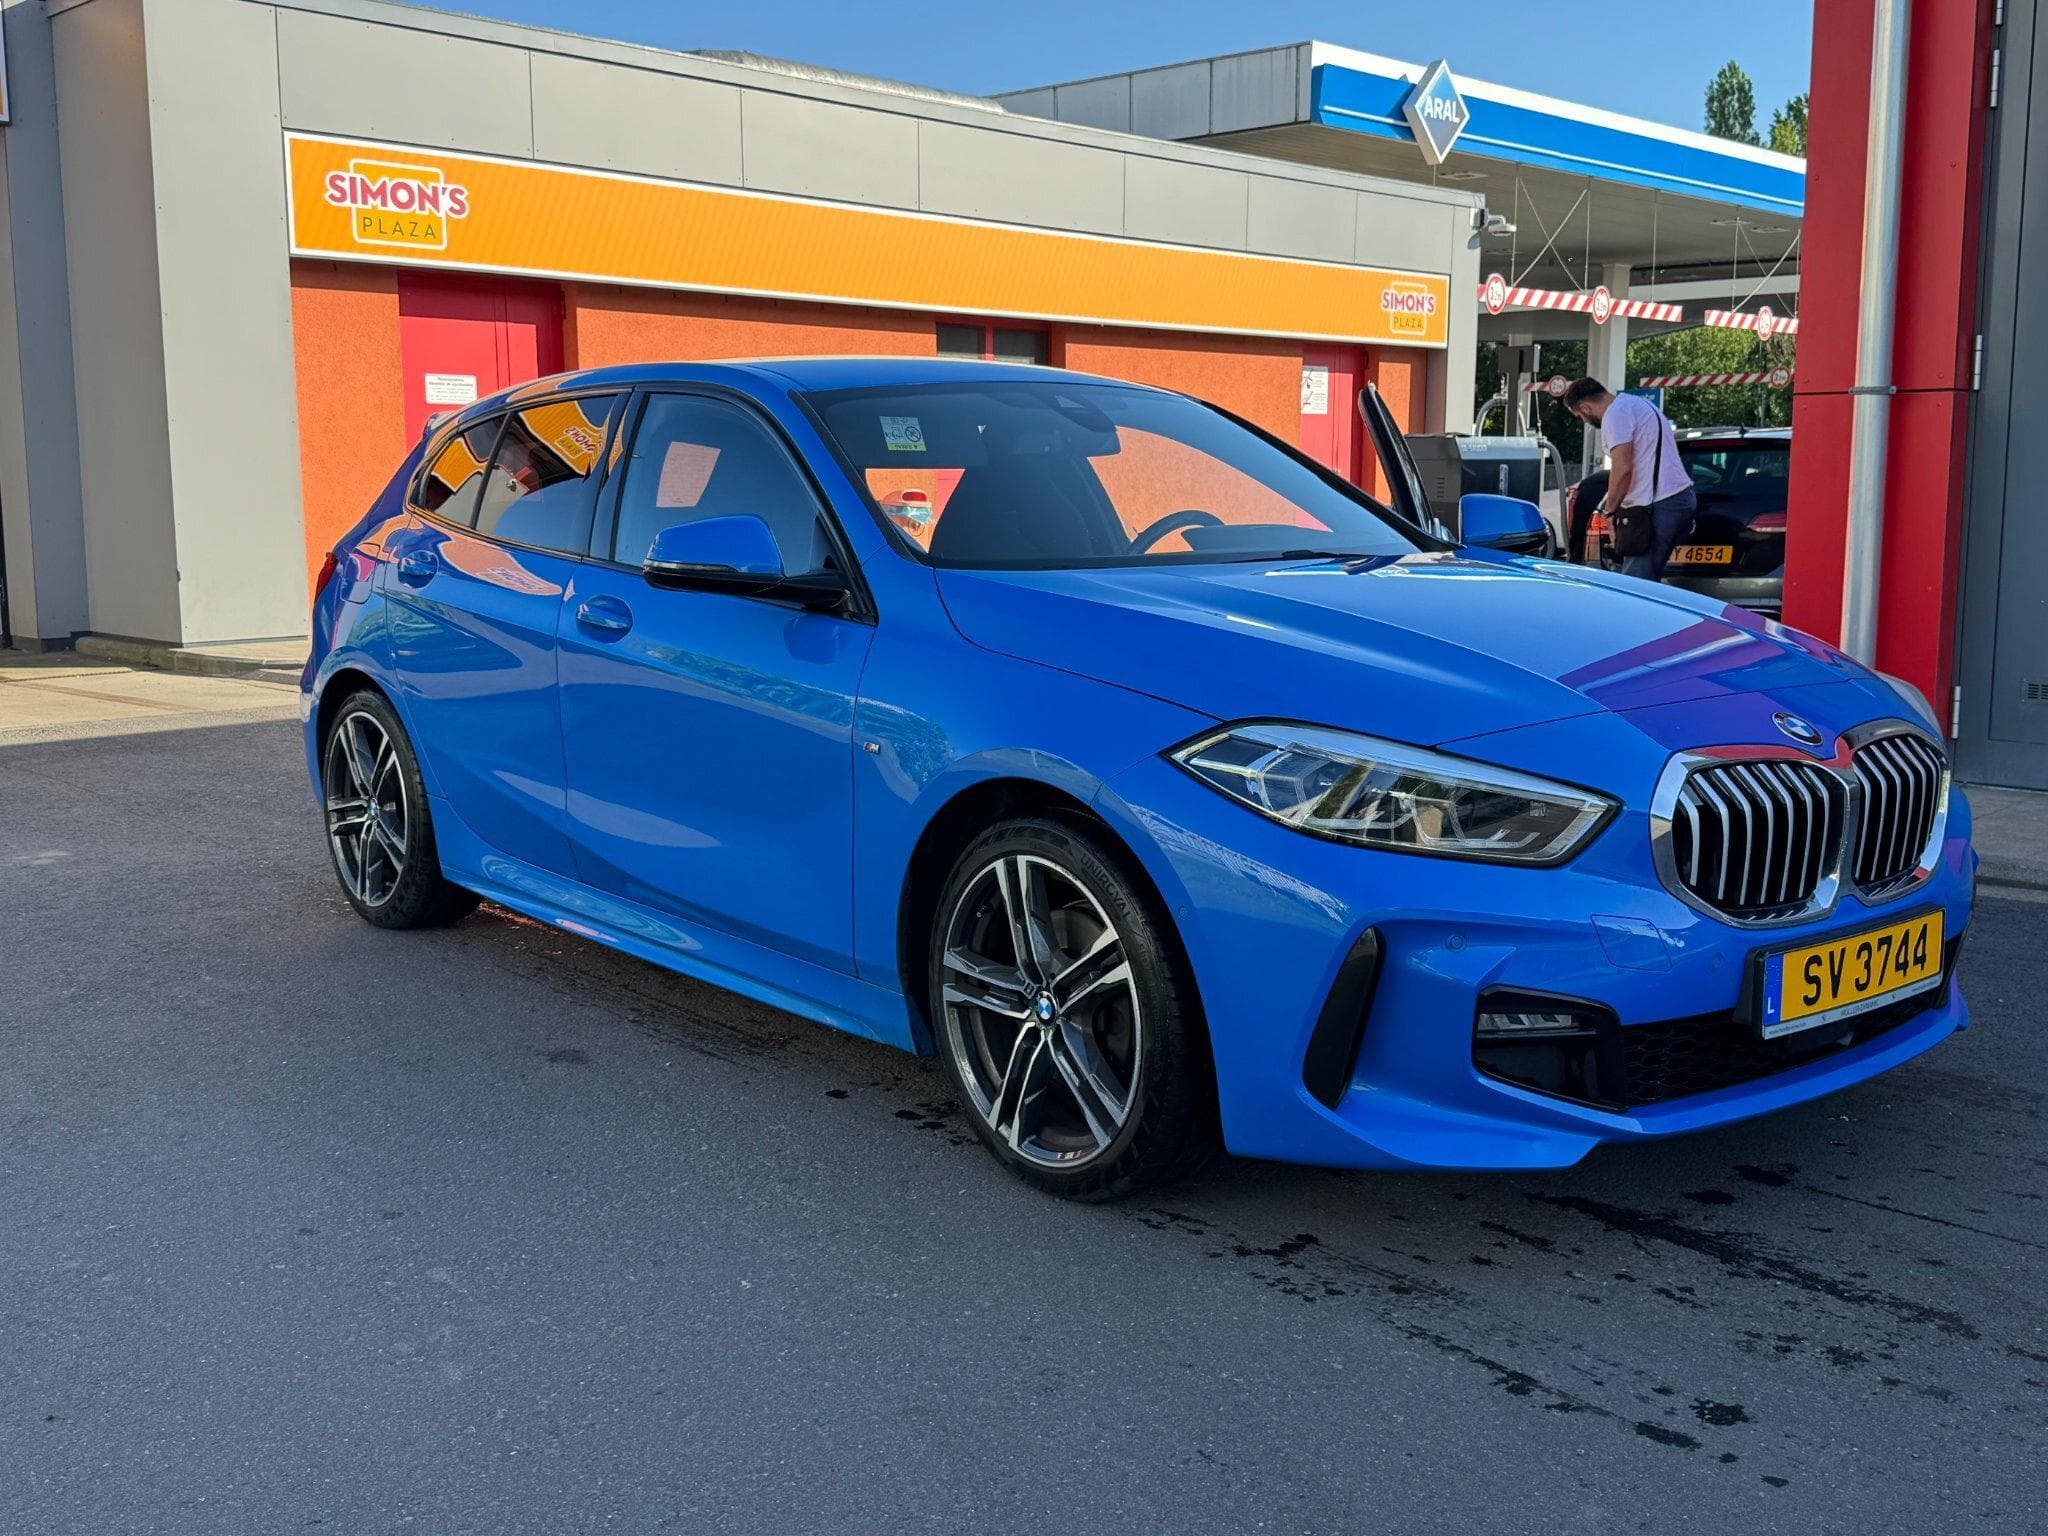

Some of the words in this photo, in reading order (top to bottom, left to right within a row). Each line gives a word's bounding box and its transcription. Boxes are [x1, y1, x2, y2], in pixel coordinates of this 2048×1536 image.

[1424, 95, 1460, 123] ARAL
[327, 173, 468, 216] SIMON'S
[362, 216, 437, 239] PLAZA
[1382, 291, 1435, 314] SIMON'S
[1393, 316, 1423, 329] PLAZA
[1685, 547, 1724, 561] 4654
[1802, 947, 1847, 1007] SV
[1854, 923, 1928, 992] 3744
